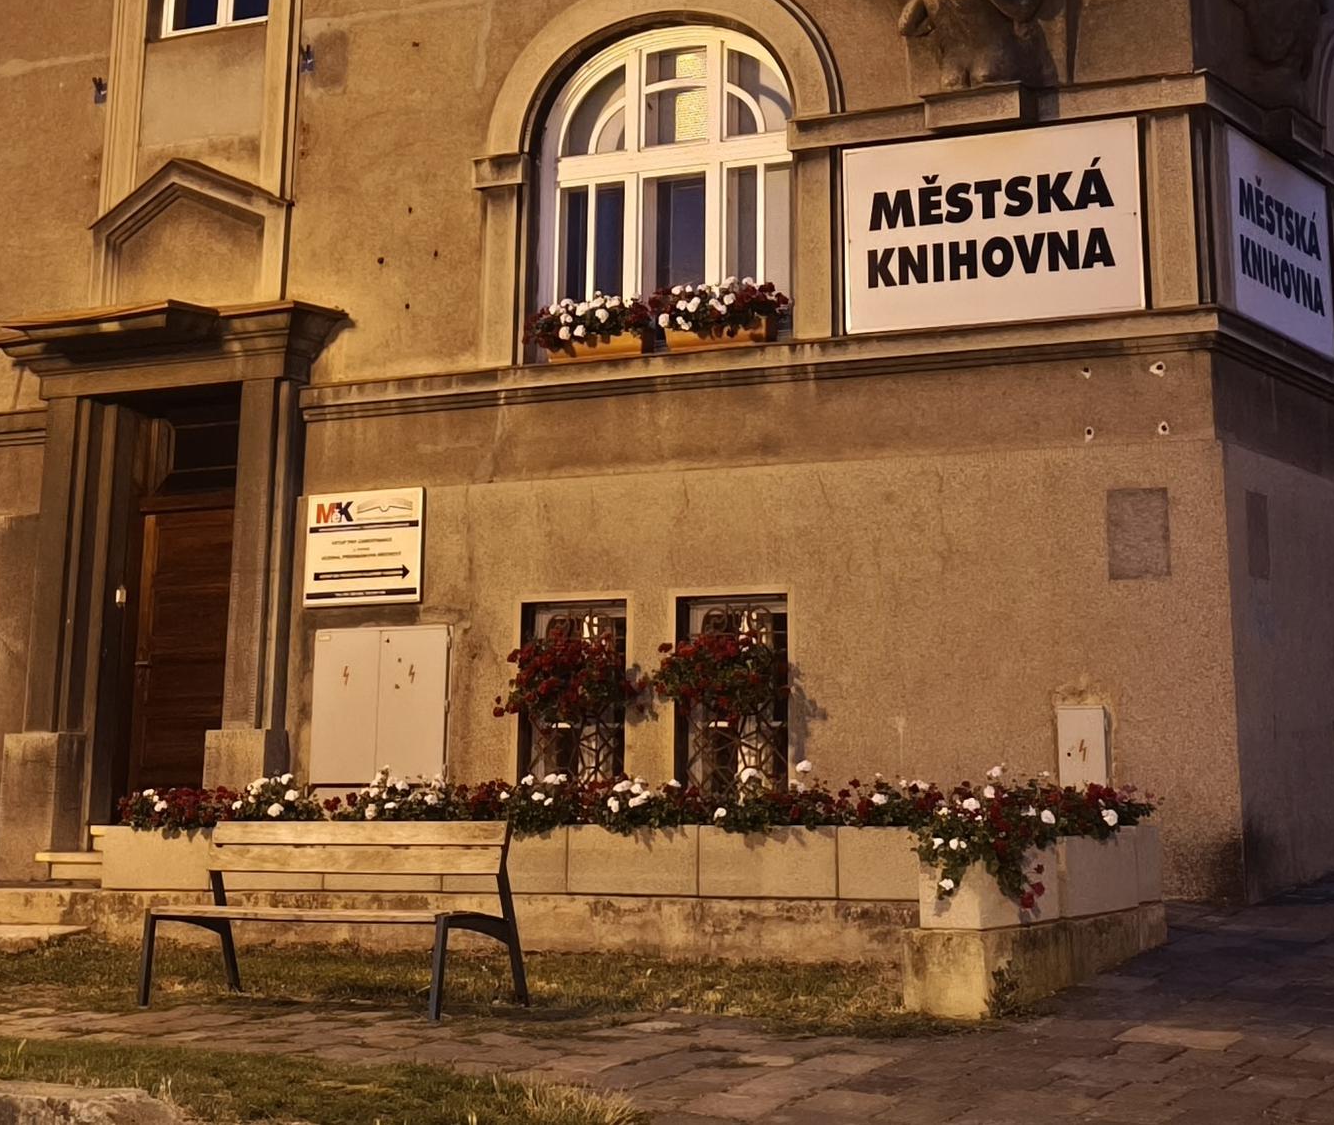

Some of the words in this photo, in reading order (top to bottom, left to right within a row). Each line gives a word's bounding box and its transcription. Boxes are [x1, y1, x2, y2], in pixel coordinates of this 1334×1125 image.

[869, 158, 1114, 231] MĚSTSKÁ
[1239, 176, 1321, 261] MĚSTSKÁ
[868, 228, 1115, 289] KNIHOVNA
[1241, 234, 1325, 317] KNIHOVNA
